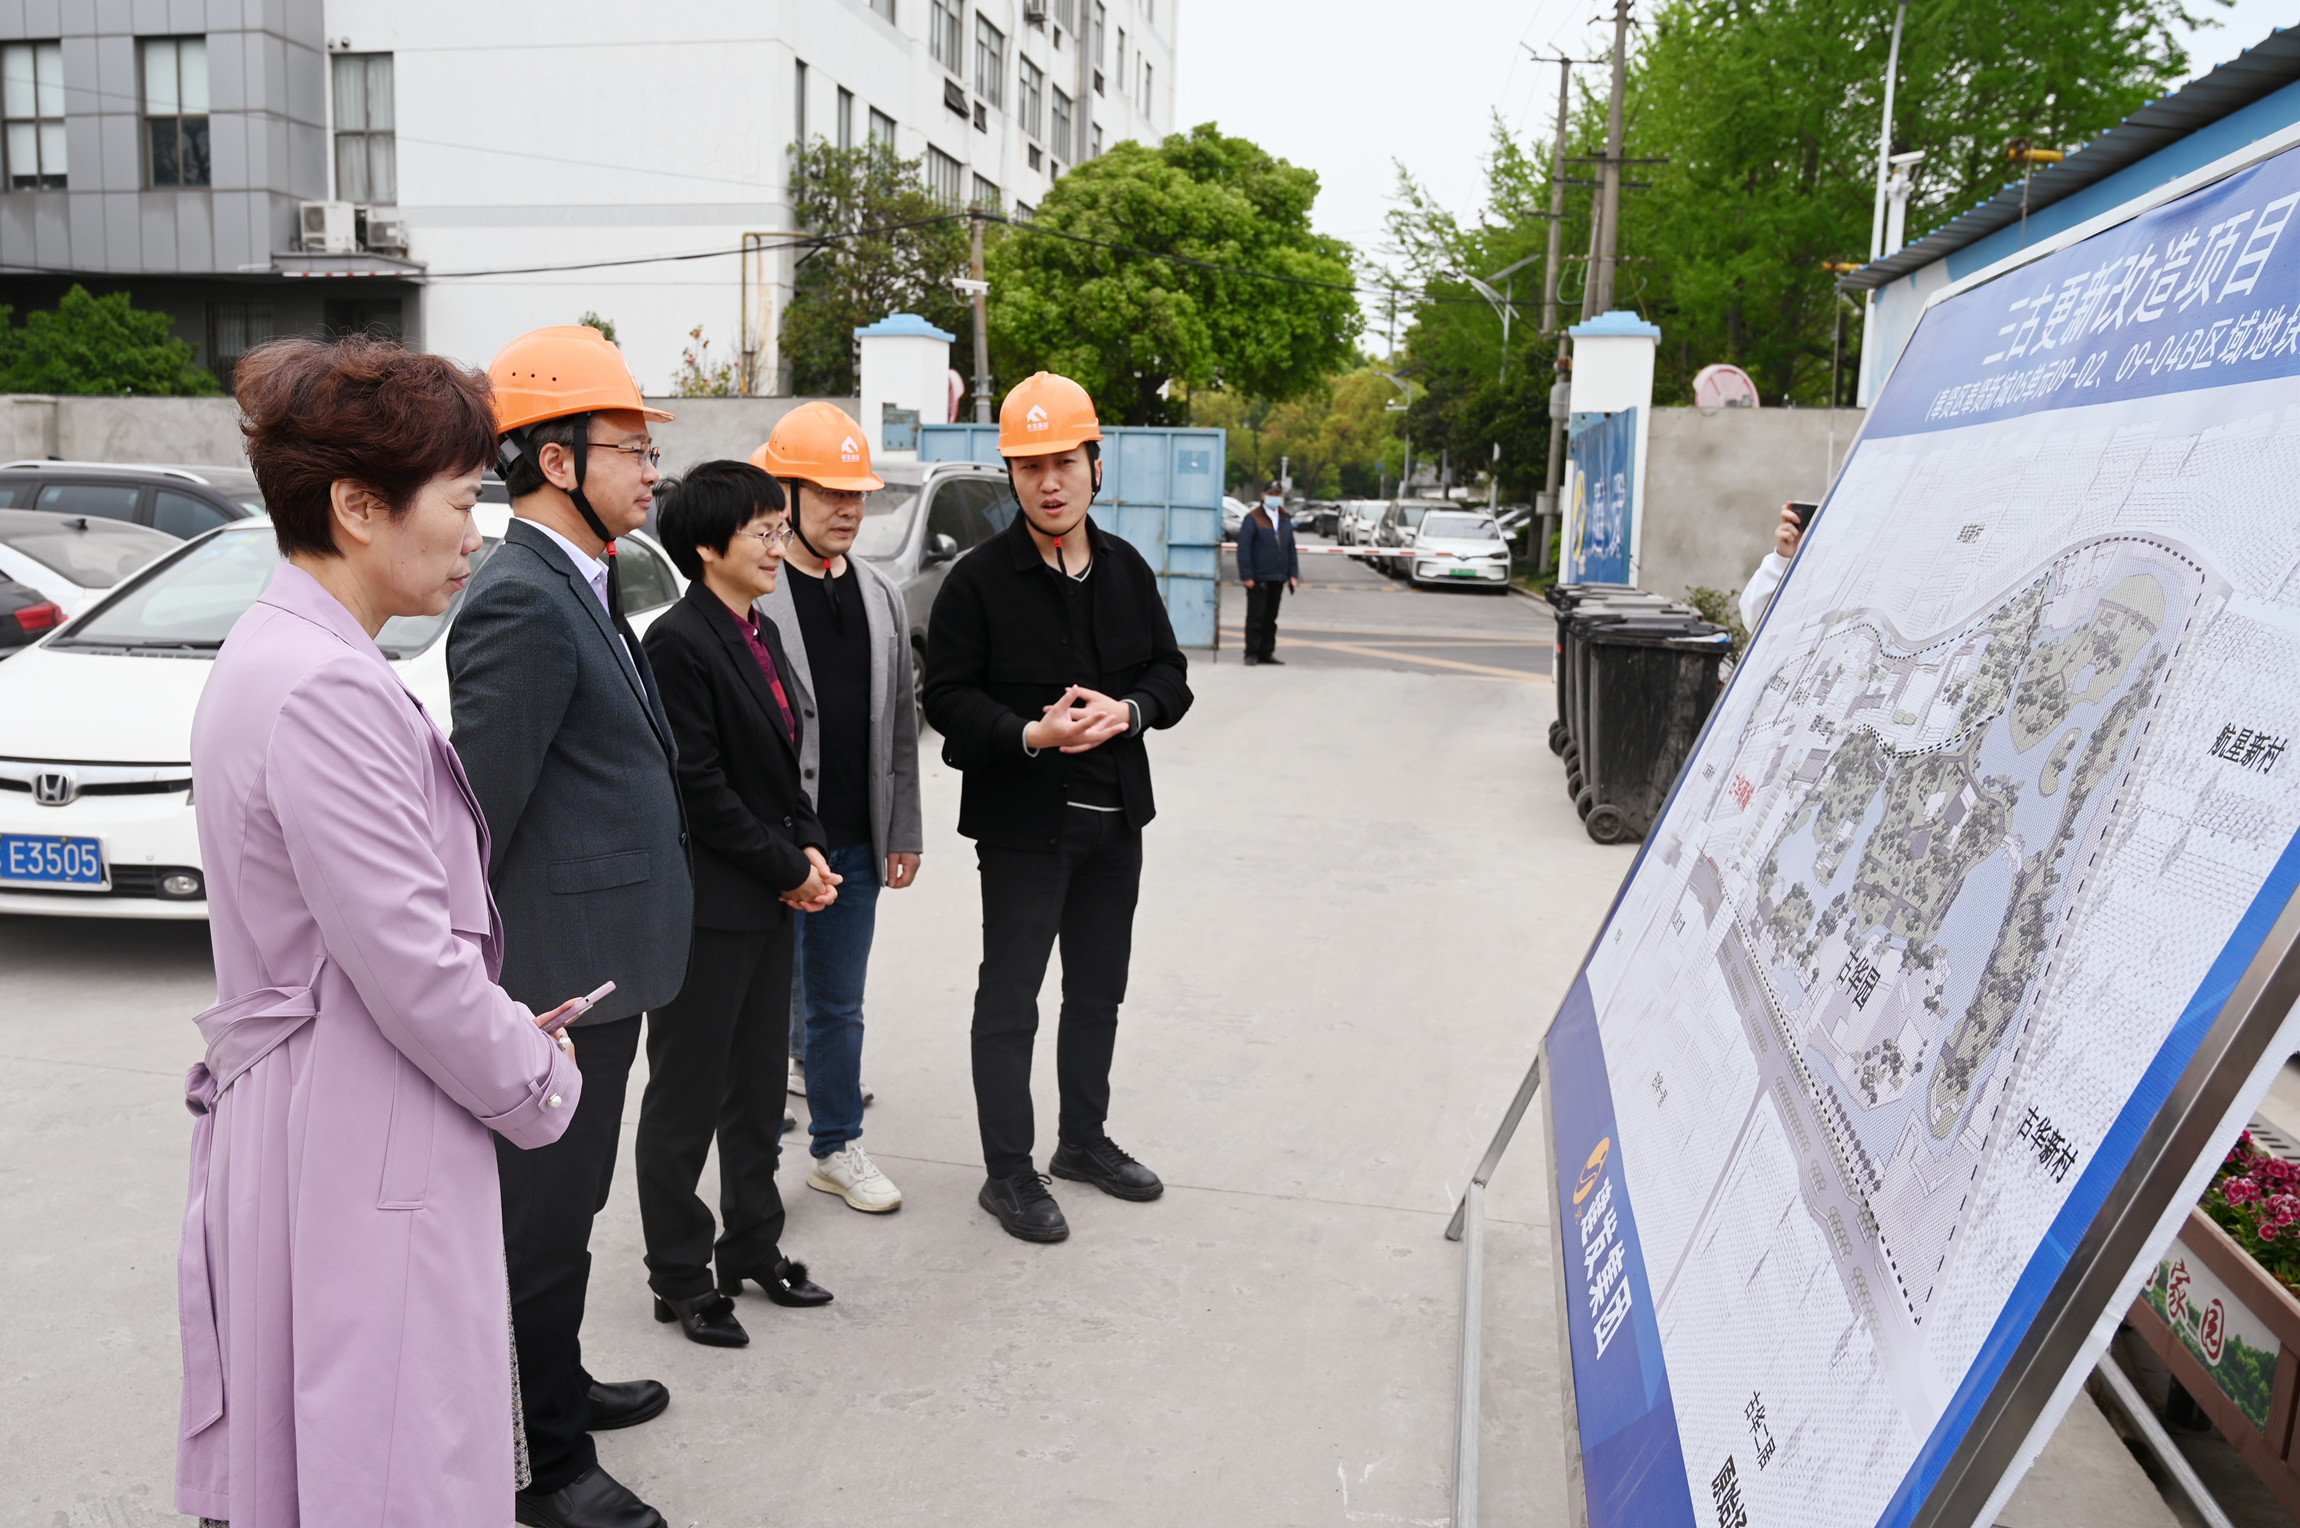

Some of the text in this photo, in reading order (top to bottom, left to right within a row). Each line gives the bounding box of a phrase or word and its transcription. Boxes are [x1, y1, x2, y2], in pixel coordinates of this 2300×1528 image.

[1982, 190, 2300, 366] 三古更新改造项目
[9, 841, 98, 877] E3505
[1836, 947, 1881, 1012] 古华园
[2017, 1105, 2078, 1184] 古华新村
[1582, 1176, 1633, 1362] 建发集团
[2146, 1257, 2225, 1361] 家园
[1744, 1390, 1776, 1472] 古华二居
